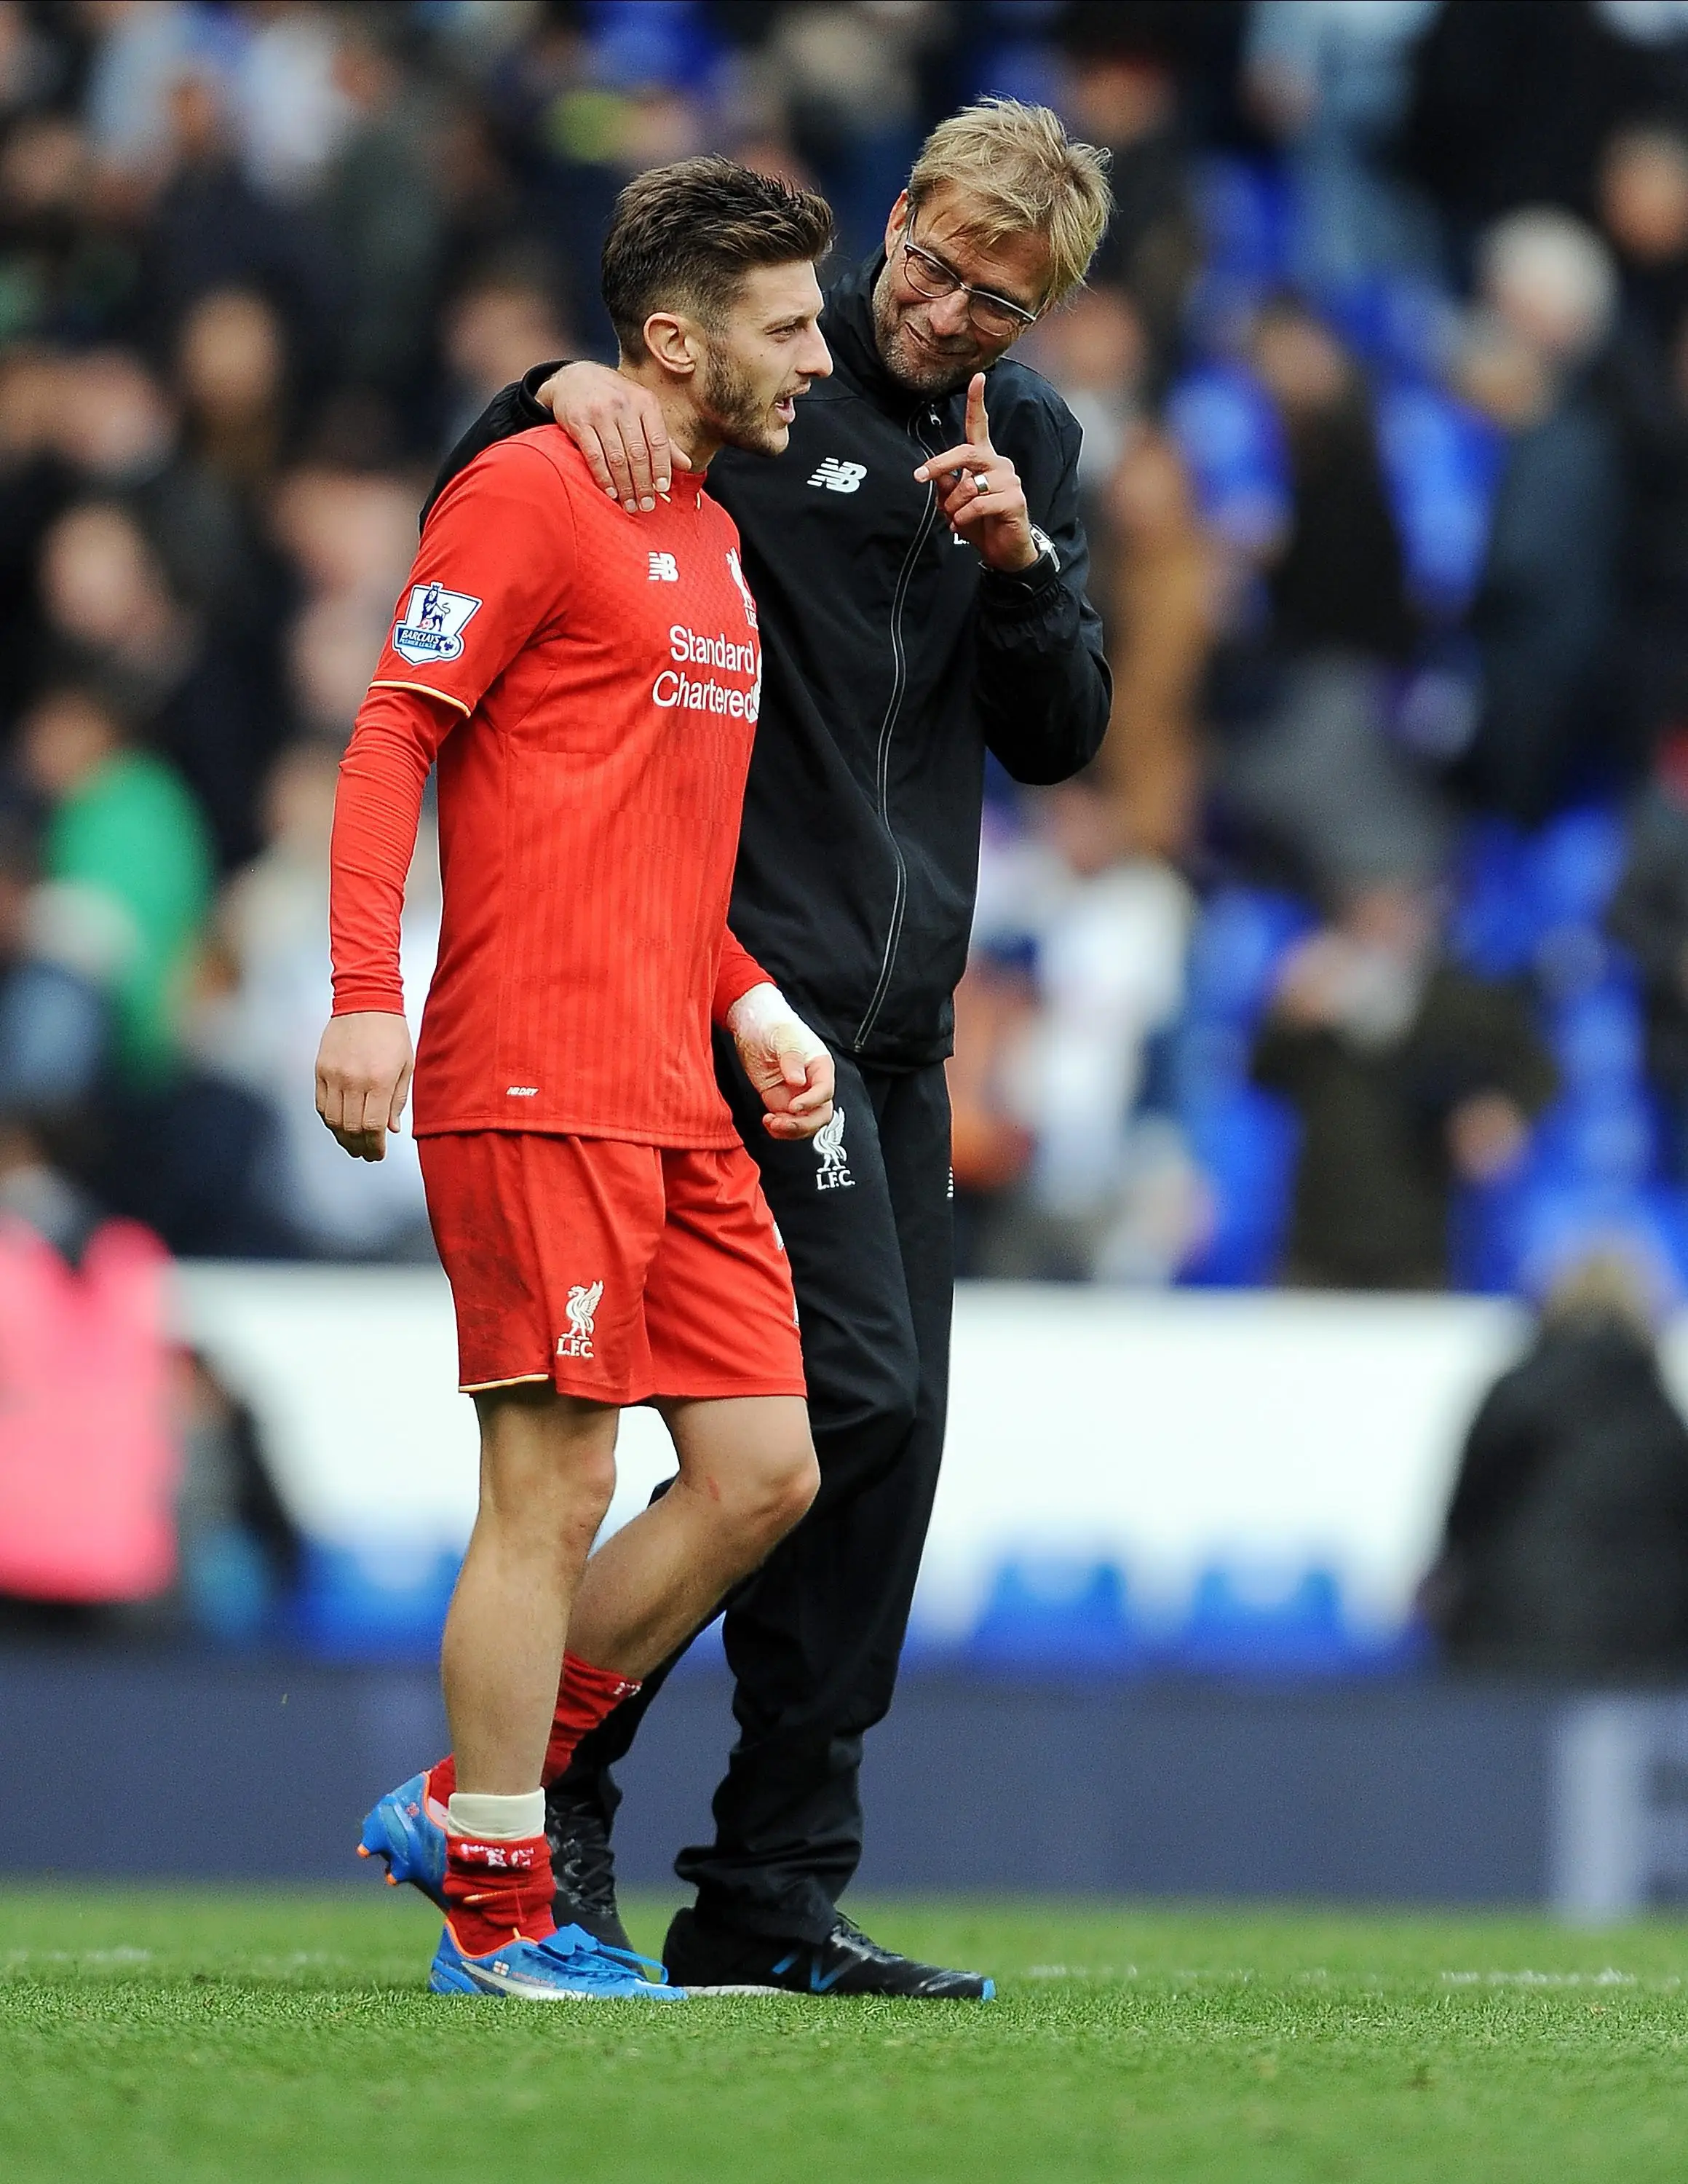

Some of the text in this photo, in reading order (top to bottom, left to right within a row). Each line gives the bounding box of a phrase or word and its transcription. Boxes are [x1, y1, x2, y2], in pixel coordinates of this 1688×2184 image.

[401, 630, 441, 644] BARCLAYS
[669, 625, 754, 675] Standard
[652, 670, 754, 722] Chartered
